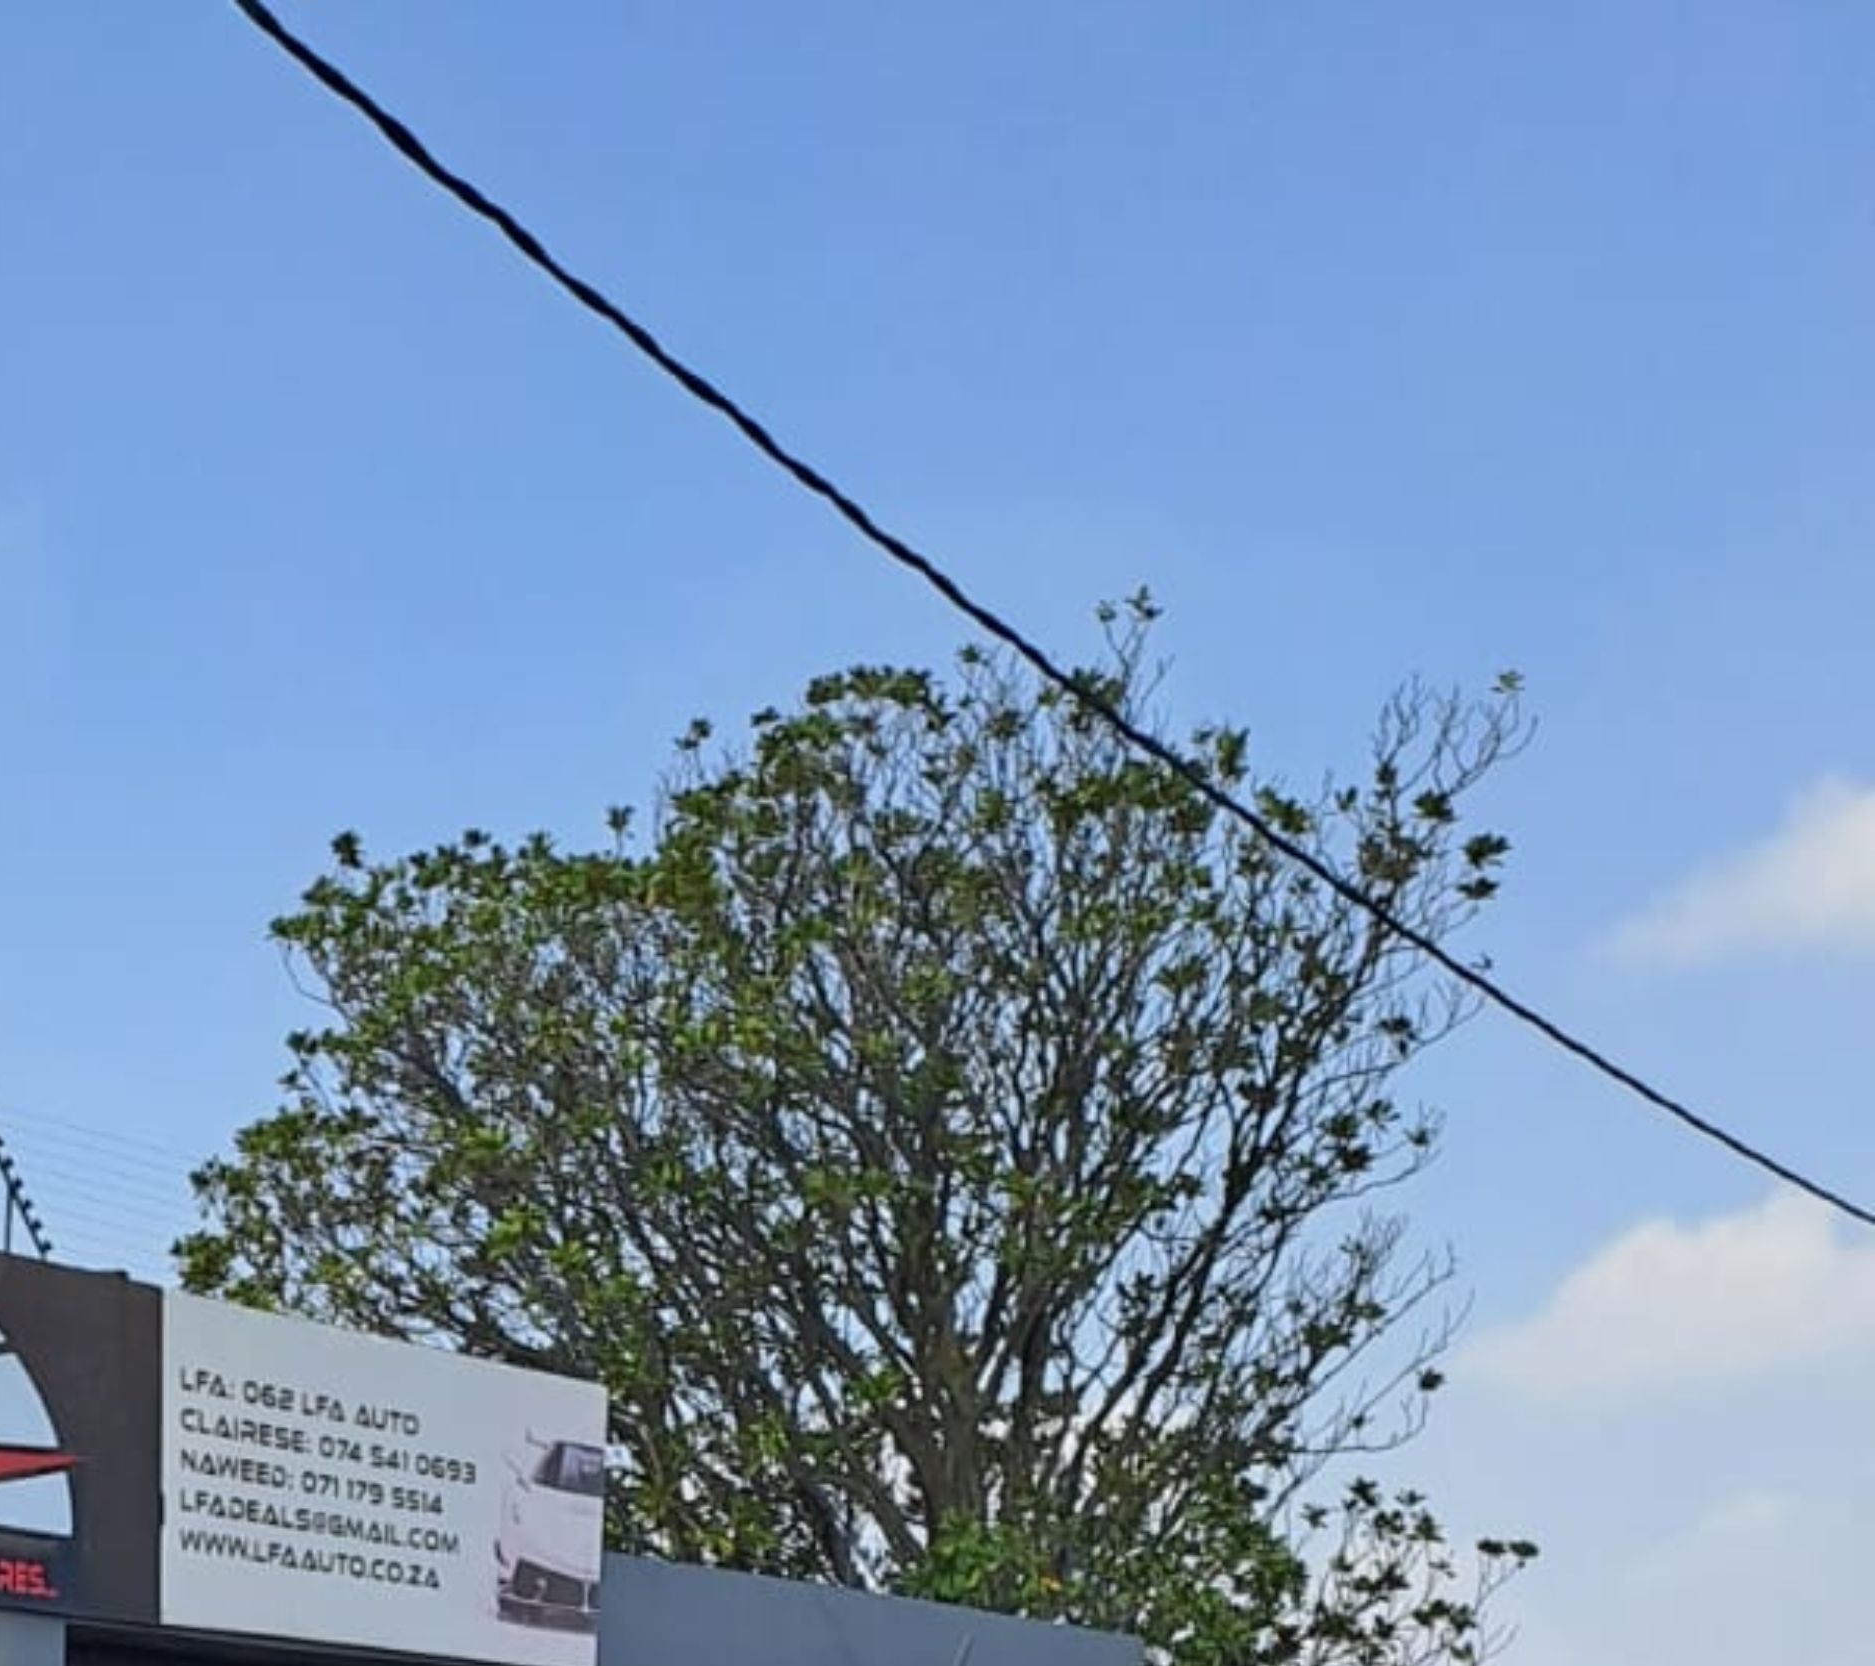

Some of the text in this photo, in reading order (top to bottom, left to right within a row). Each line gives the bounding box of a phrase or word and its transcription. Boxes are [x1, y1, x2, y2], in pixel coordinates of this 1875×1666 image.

[179, 1367, 420, 1436] LFA: 062 LFA AUTO
[179, 1408, 478, 1485] CLAIRESE: 074 541 0693
[179, 1448, 295, 1492] NAWEED:
[179, 1489, 460, 1555] LFADEALS@GMAIL.COM
[179, 1528, 441, 1590] WWW.LFAAUTO.CO.ZA
